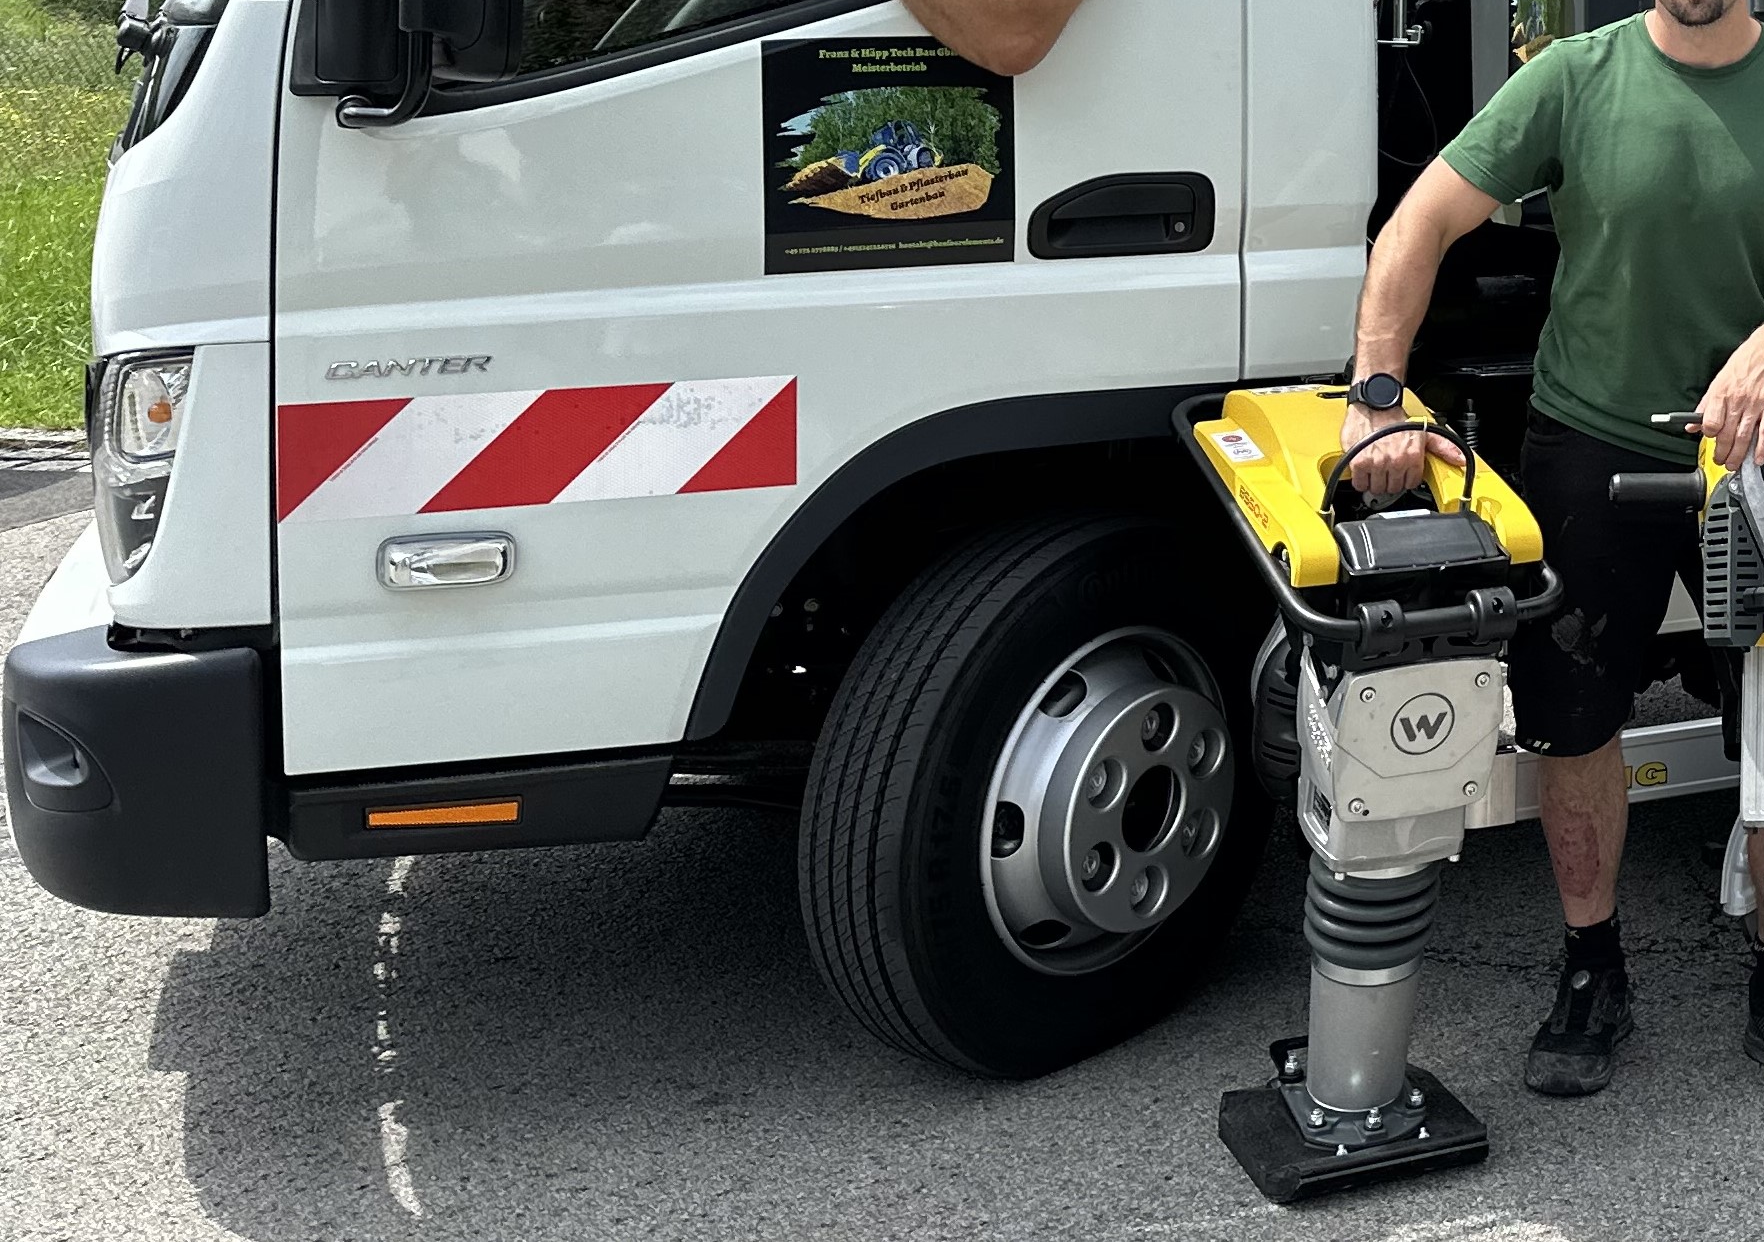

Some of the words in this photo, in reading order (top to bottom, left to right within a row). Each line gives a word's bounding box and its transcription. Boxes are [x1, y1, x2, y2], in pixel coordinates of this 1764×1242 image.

[818, 49, 849, 59] Franz
[850, 48, 859, 58] &
[890, 47, 914, 57] Tech
[916, 47, 936, 57] Bau
[852, 62, 928, 73] Meisterbetrieb
[858, 186, 900, 205] Tiefbau
[909, 168, 969, 192] Pflasterbau
[890, 191, 945, 211] Gartenbau
[325, 355, 495, 380] CANTER
